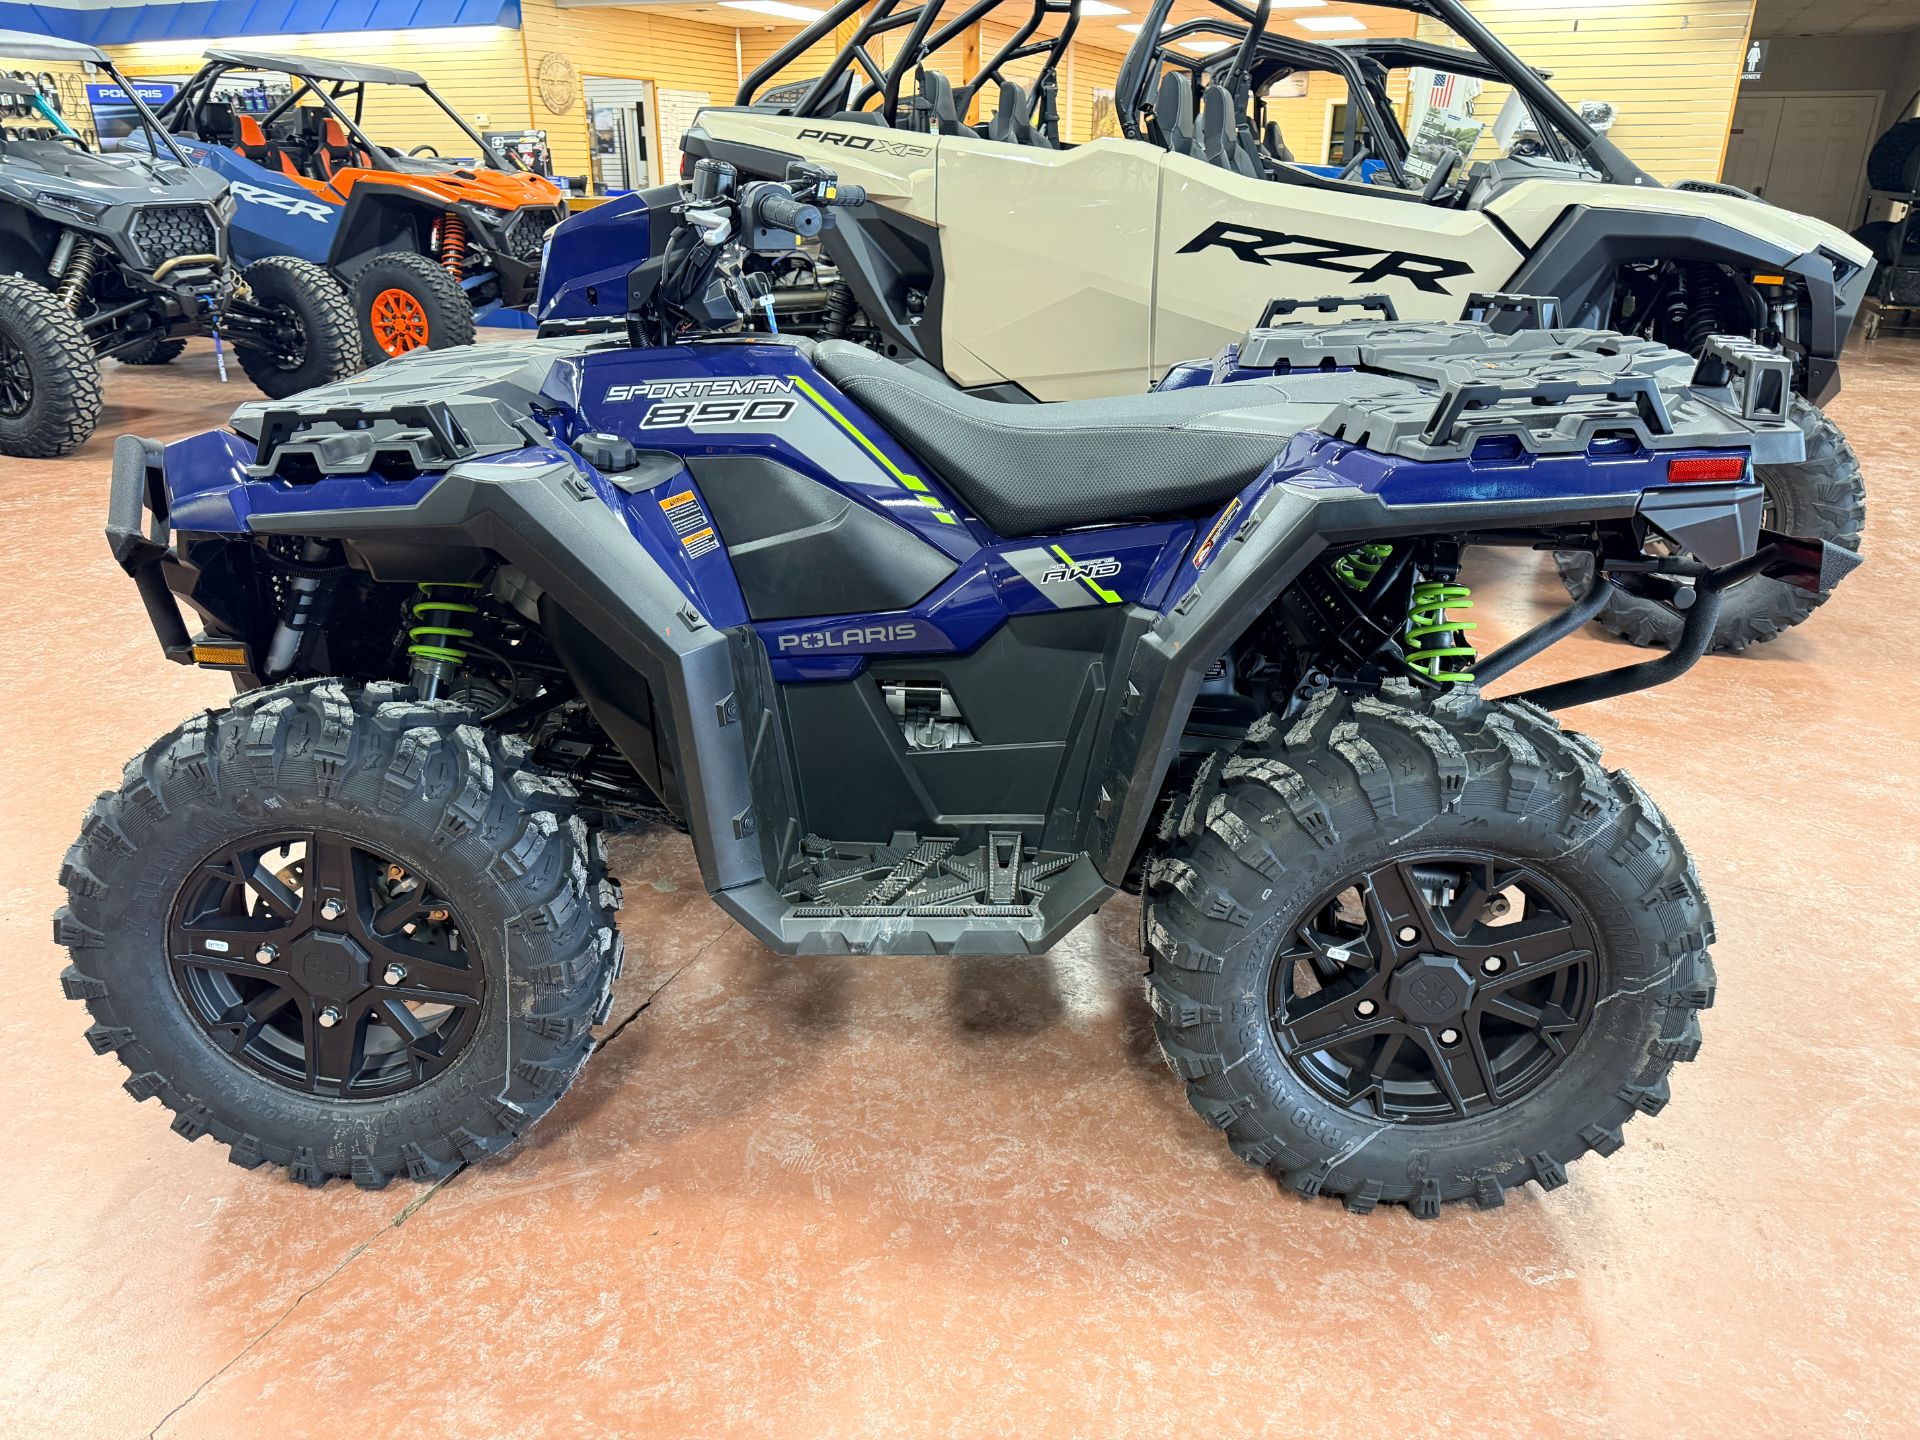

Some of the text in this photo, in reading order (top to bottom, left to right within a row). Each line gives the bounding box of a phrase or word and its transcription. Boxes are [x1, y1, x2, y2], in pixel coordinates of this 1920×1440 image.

[796, 129, 932, 157] PRO XP
[230, 181, 335, 223] RZR
[1175, 220, 1475, 297] RZR
[604, 379, 796, 403] SPORTSMAN
[639, 399, 799, 430] 850
[1040, 562, 1122, 584] AWD
[778, 624, 917, 651] POLARIS
